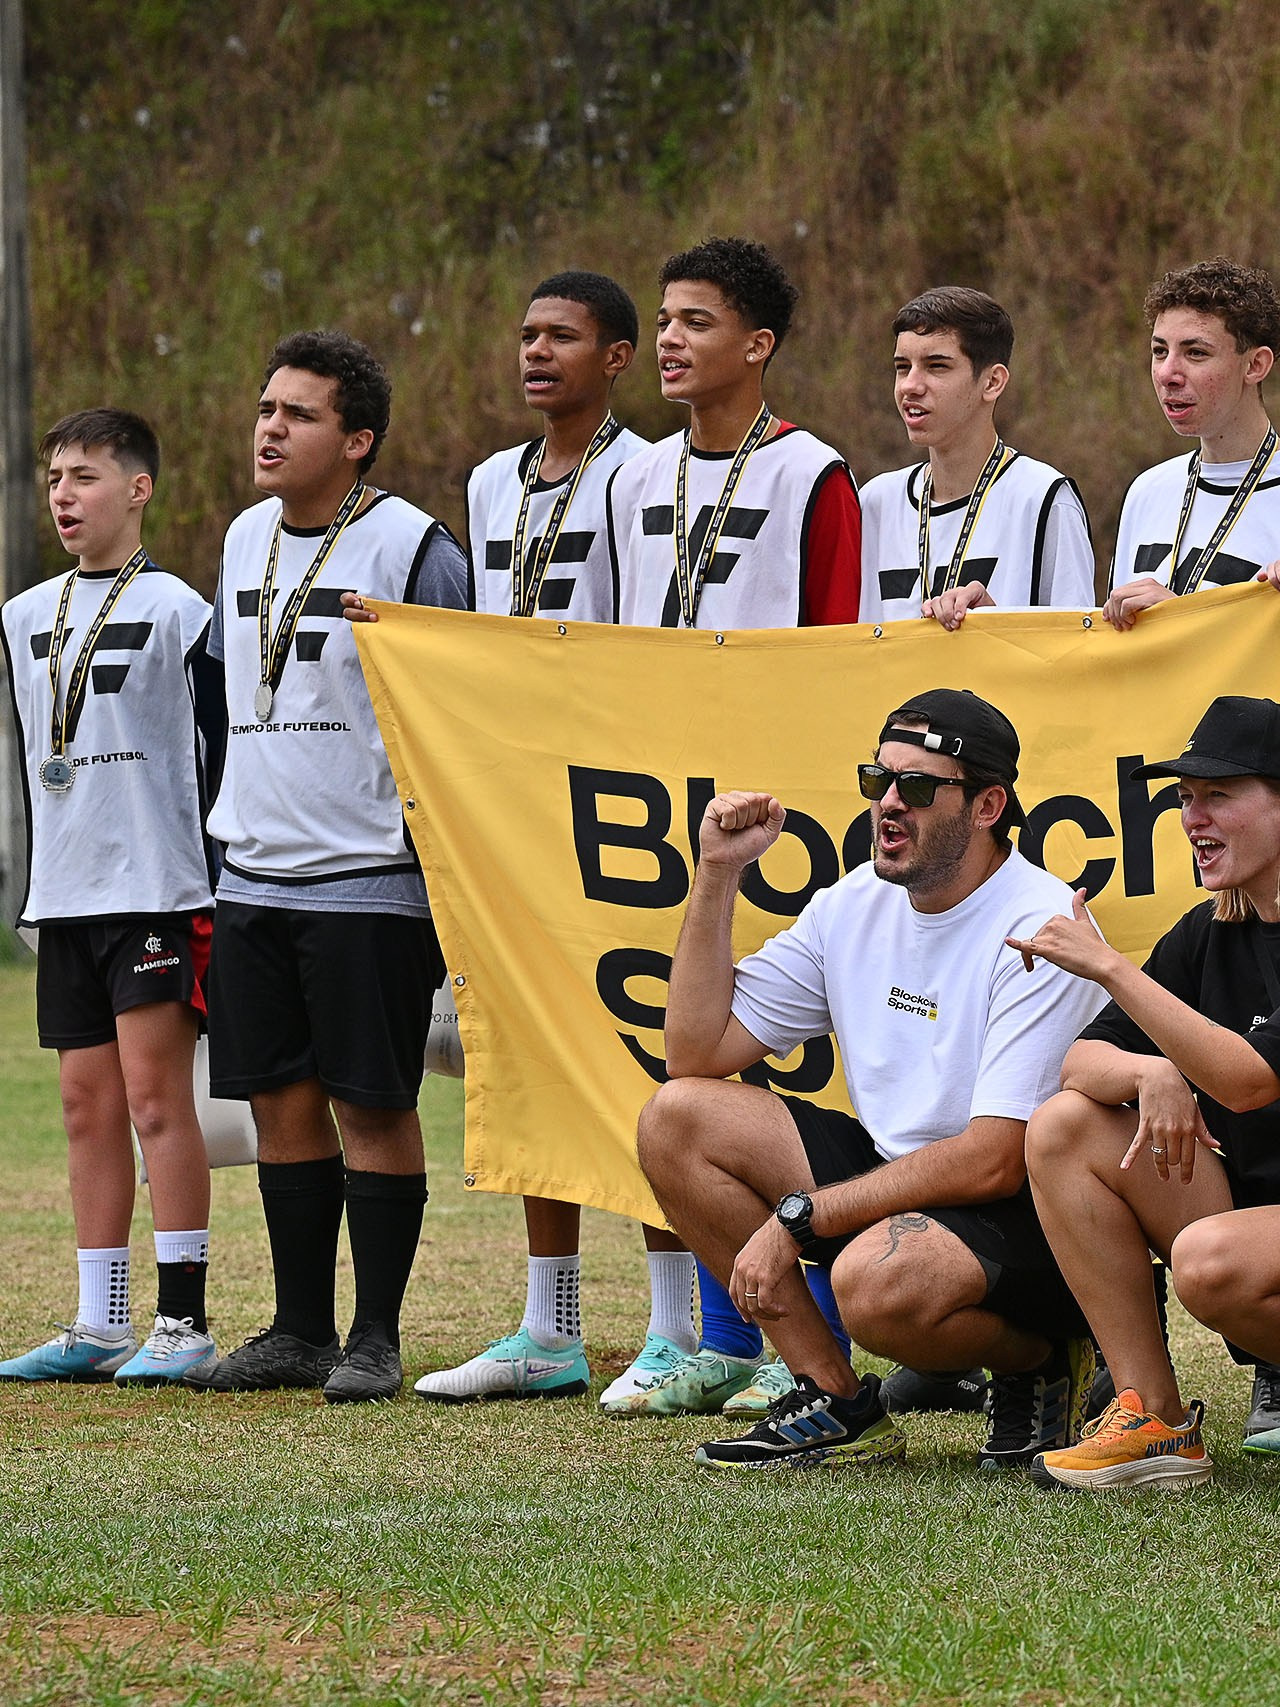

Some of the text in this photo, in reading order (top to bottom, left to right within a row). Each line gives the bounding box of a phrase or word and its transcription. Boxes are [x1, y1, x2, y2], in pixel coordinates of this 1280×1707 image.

[266, 723, 280, 732] DE
[283, 722, 351, 732] FUTEBOL
[73, 751, 148, 768] DE FUTEBOL
[54, 767, 61, 776] 2
[133, 956, 180, 974] FLAMENGO
[888, 997, 927, 1017] Sports
